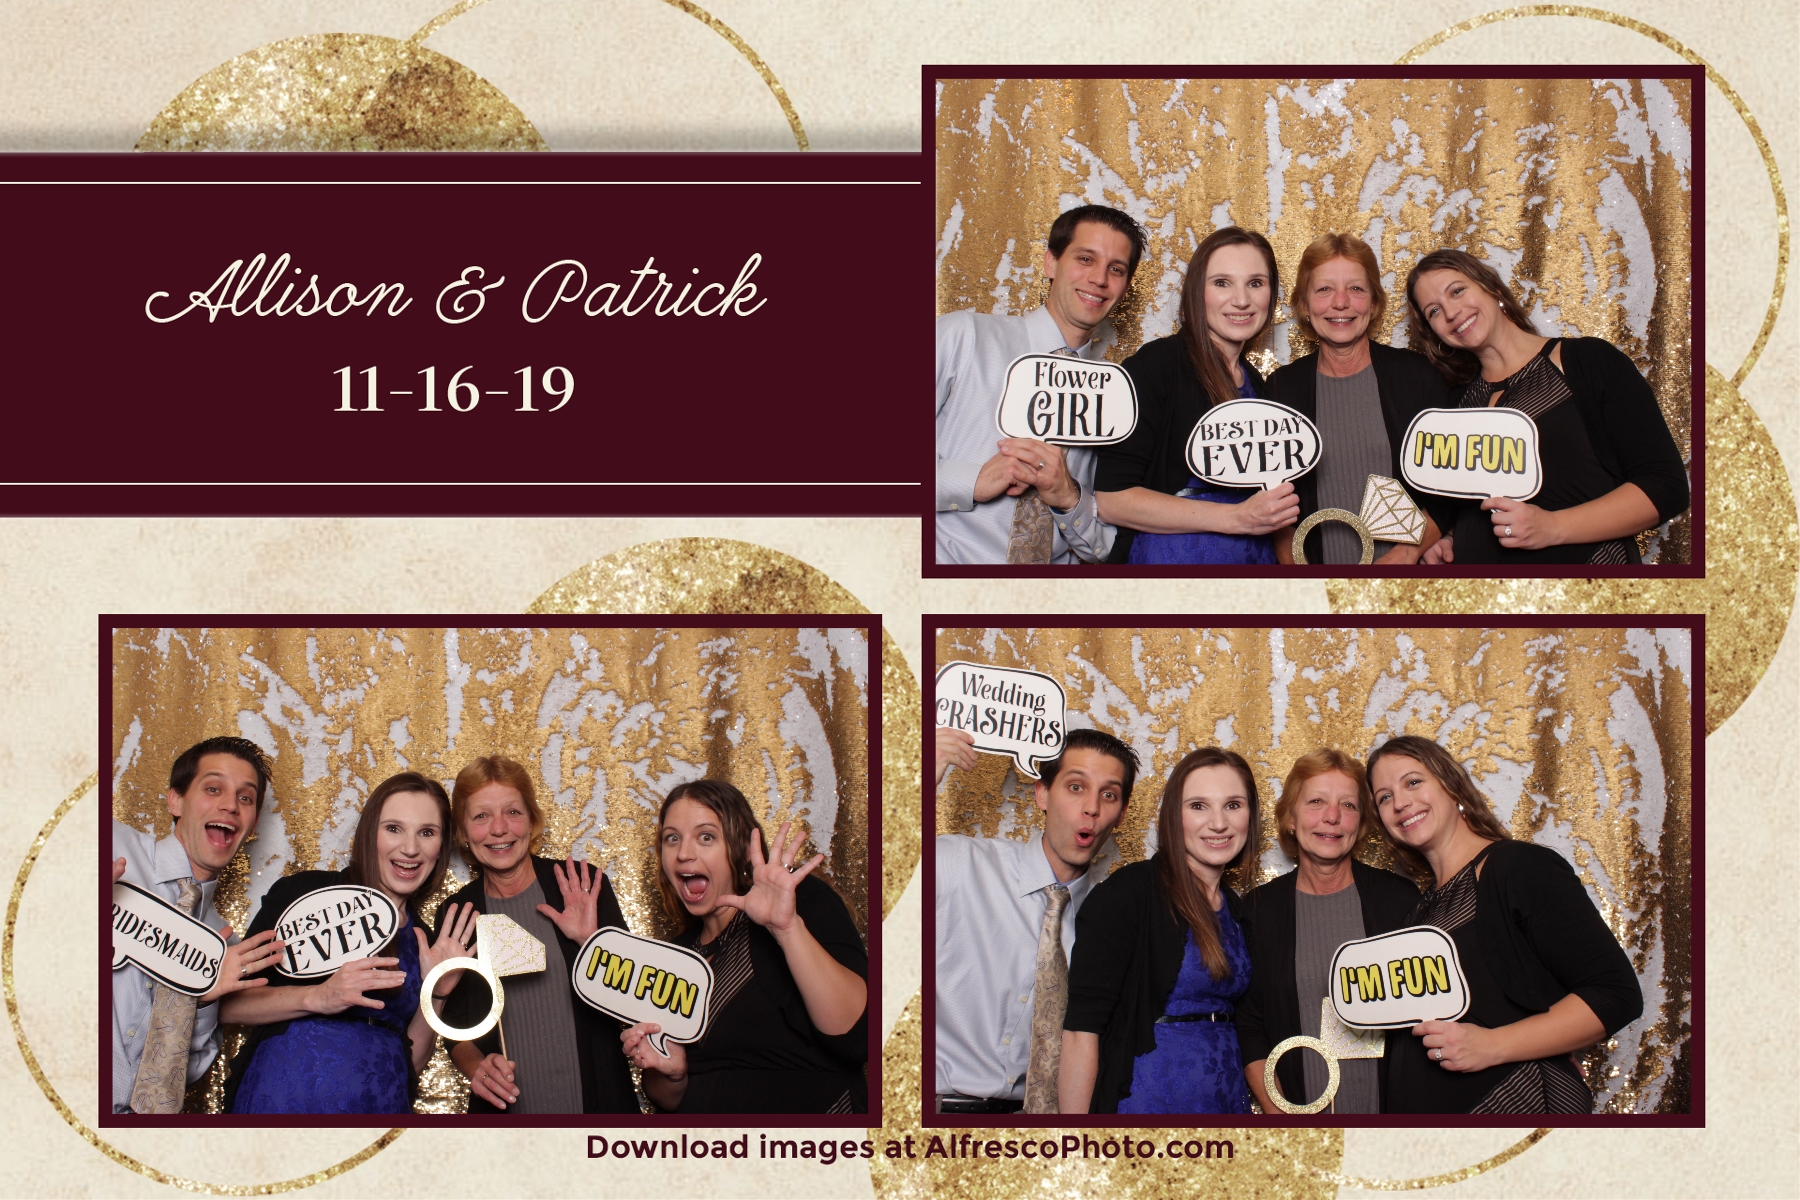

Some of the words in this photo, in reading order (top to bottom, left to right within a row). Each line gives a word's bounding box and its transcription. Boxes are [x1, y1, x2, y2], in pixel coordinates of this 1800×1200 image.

[1034, 361, 1112, 390] Flower
[1026, 390, 1115, 438] GIRL
[1200, 419, 1259, 441] BEST
[1263, 415, 1304, 435] DAY
[1202, 439, 1310, 477] EVER
[1414, 431, 1459, 470] I'M
[1465, 434, 1526, 474] FUN
[962, 671, 1046, 716] Wedding
[936, 697, 1061, 747] CRASHERS
[278, 907, 333, 941] BEST
[336, 890, 373, 919] DAY
[284, 912, 391, 975] EVER
[586, 946, 635, 994] I'M
[634, 965, 699, 1019] FUN
[1340, 963, 1386, 1004] I'M
[1387, 955, 1451, 999] FUN
